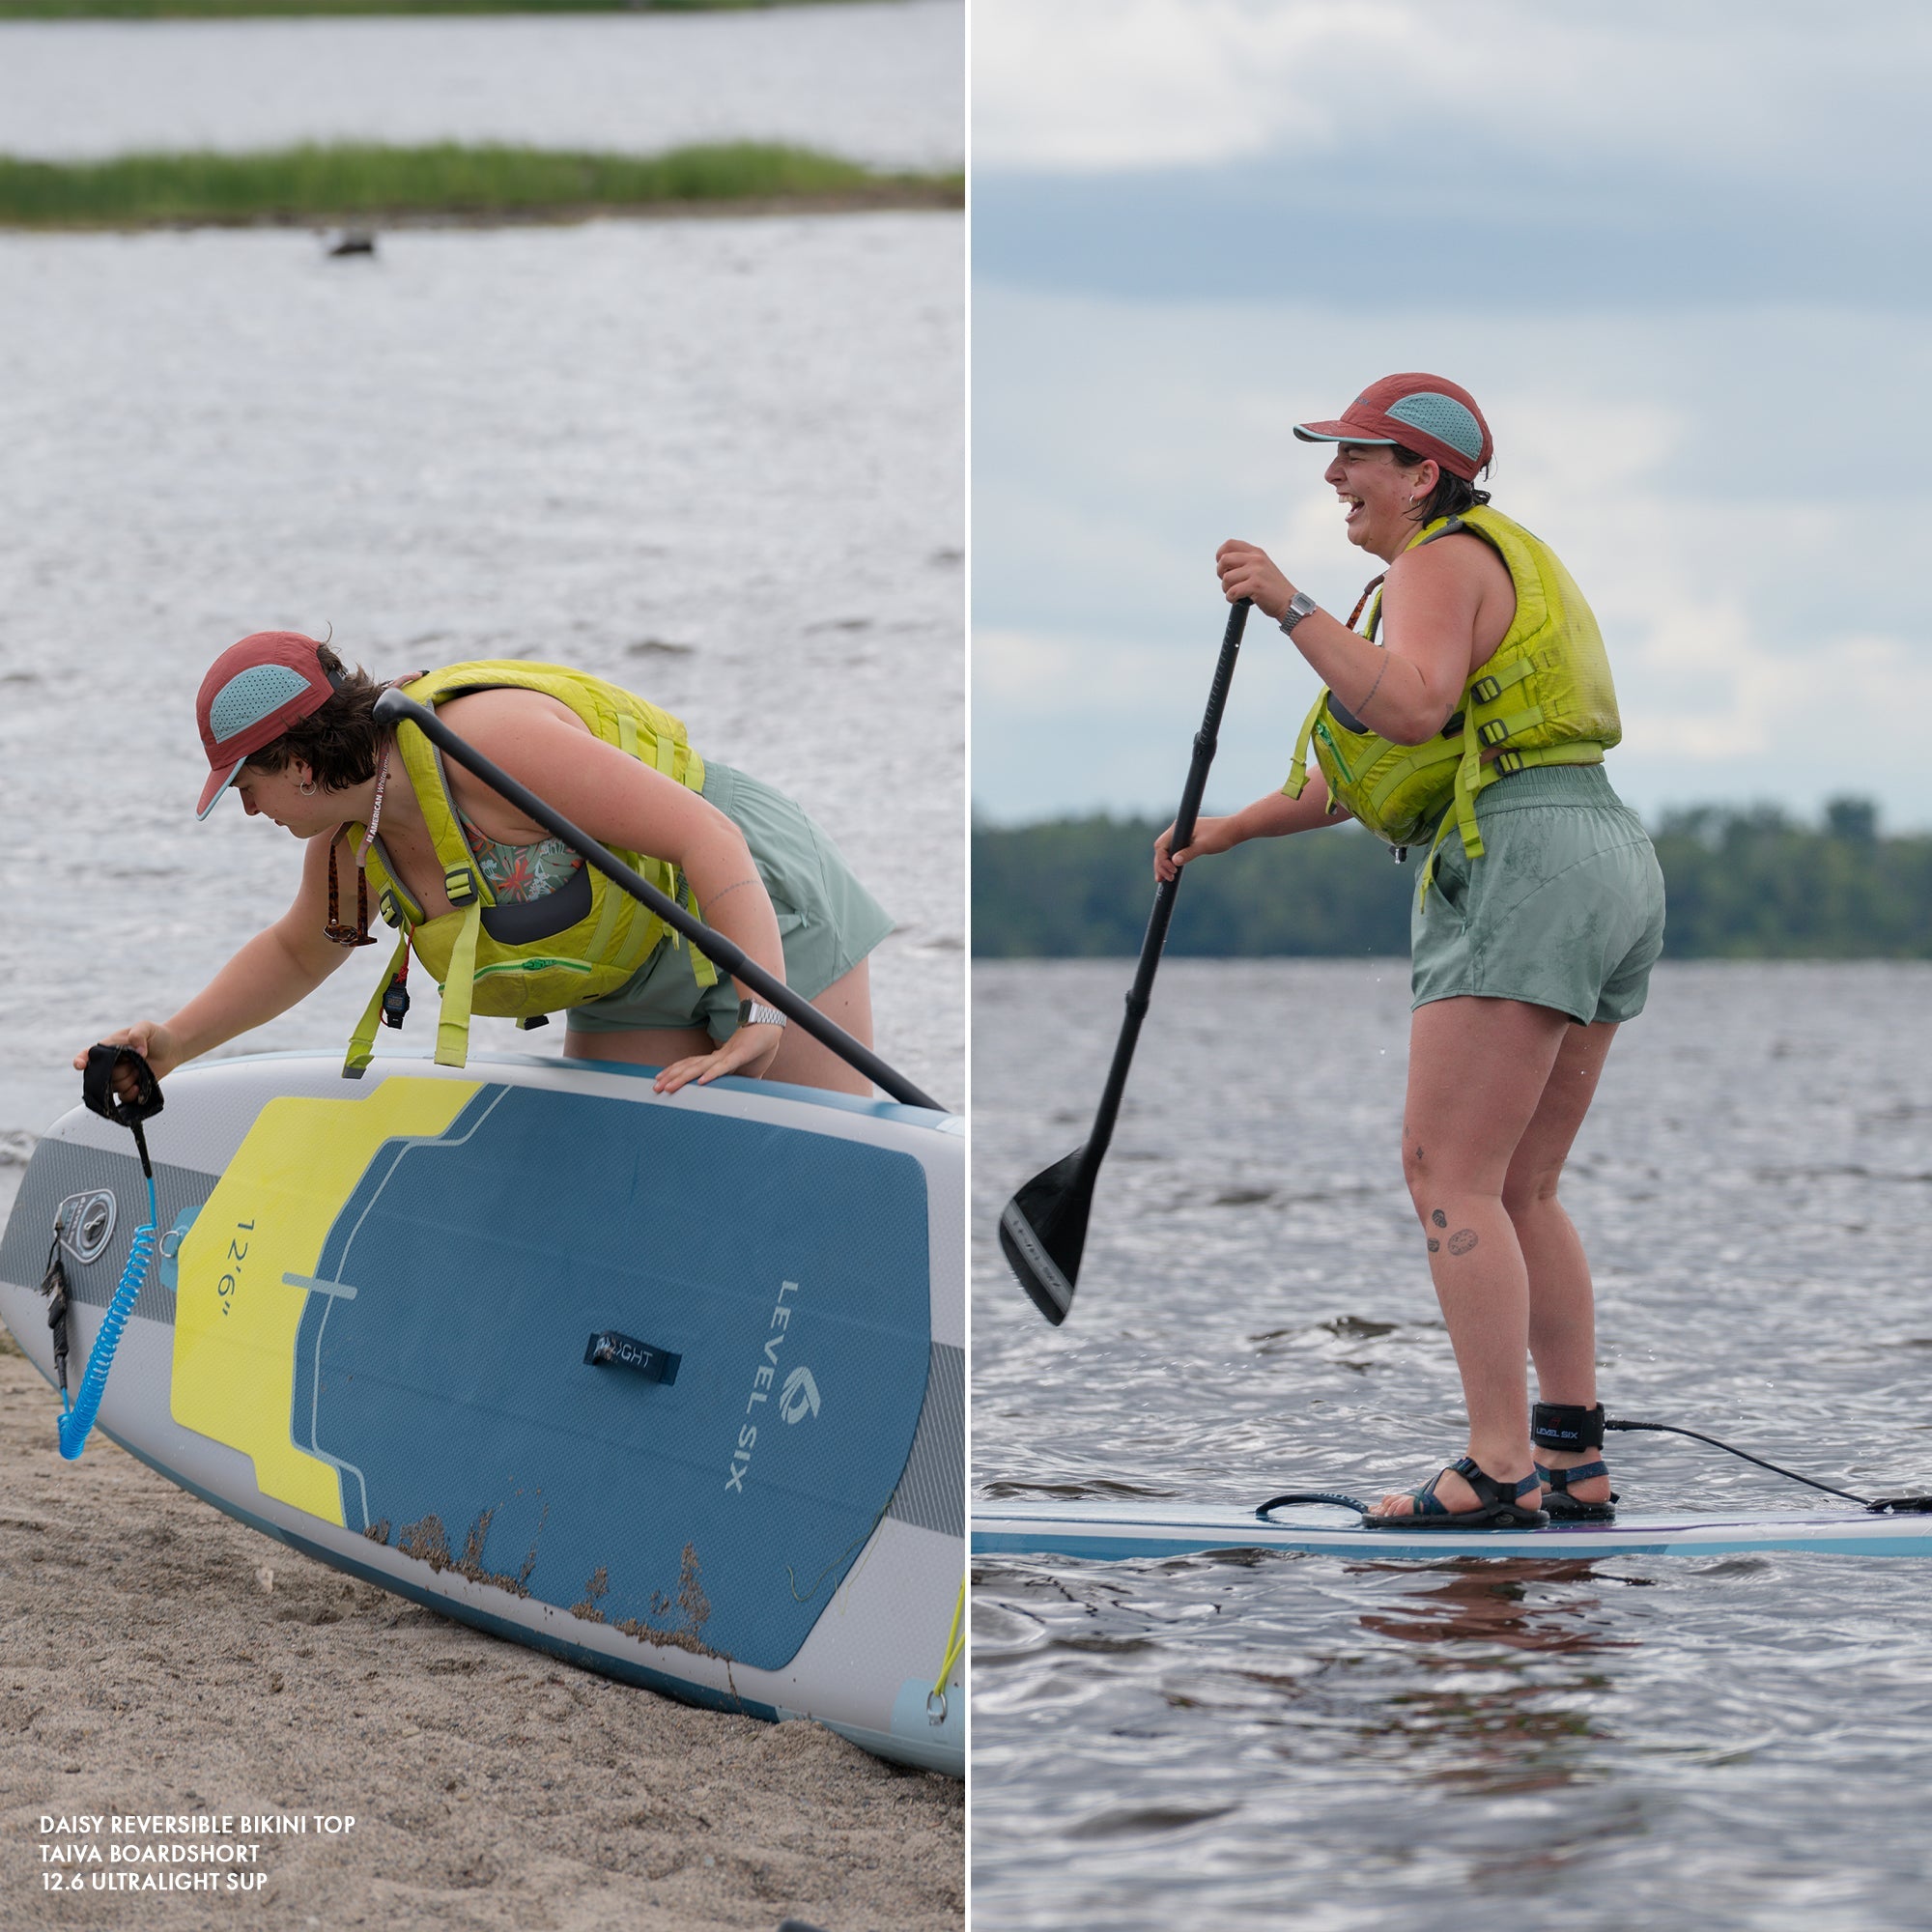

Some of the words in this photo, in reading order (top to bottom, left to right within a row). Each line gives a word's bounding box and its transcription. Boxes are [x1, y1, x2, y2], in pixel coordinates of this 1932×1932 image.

[369, 794, 383, 835] AMERICAN
[746, 1280, 799, 1414] LEVEL
[724, 1424, 757, 1493] SIX
[1536, 1428, 1560, 1437] LEVEL
[1561, 1430, 1578, 1439] SIX
